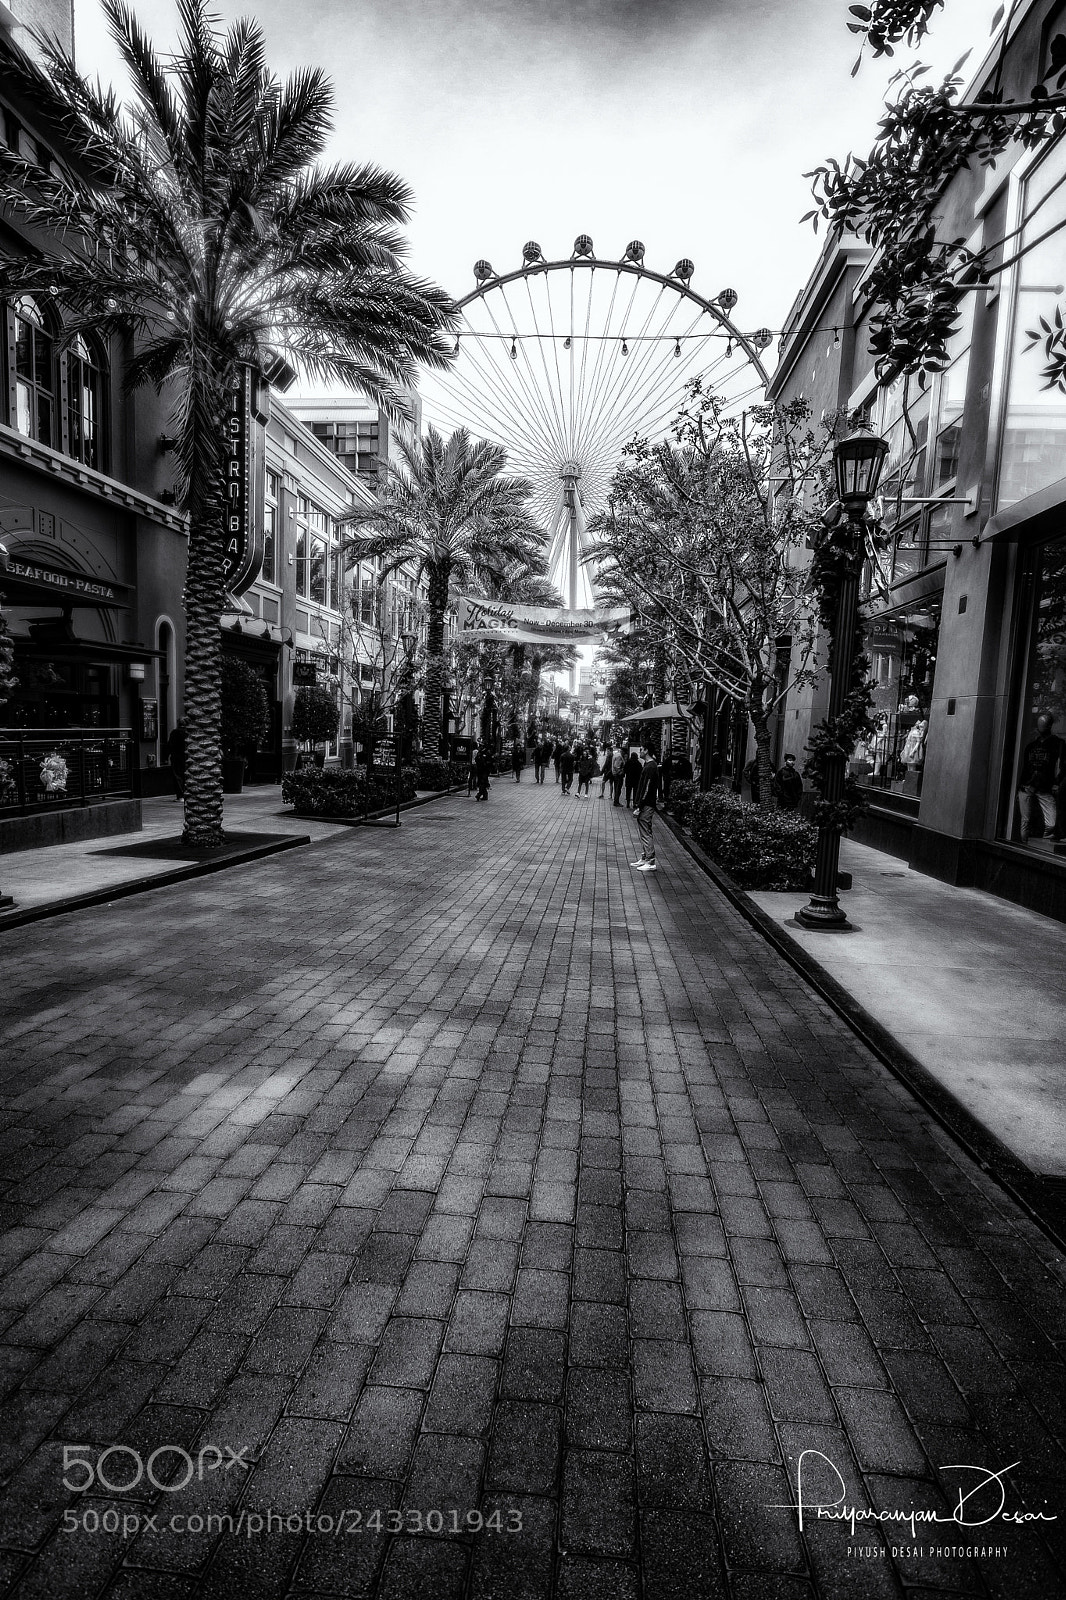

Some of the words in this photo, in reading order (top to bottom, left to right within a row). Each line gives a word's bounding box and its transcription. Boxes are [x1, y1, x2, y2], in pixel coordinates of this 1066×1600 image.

[76, 579, 114, 599] PASTA
[466, 604, 514, 621] Holiday
[463, 618, 518, 630] MAGIC
[523, 618, 540, 626] Now
[546, 620, 582, 628] December
[584, 620, 593, 628] 30
